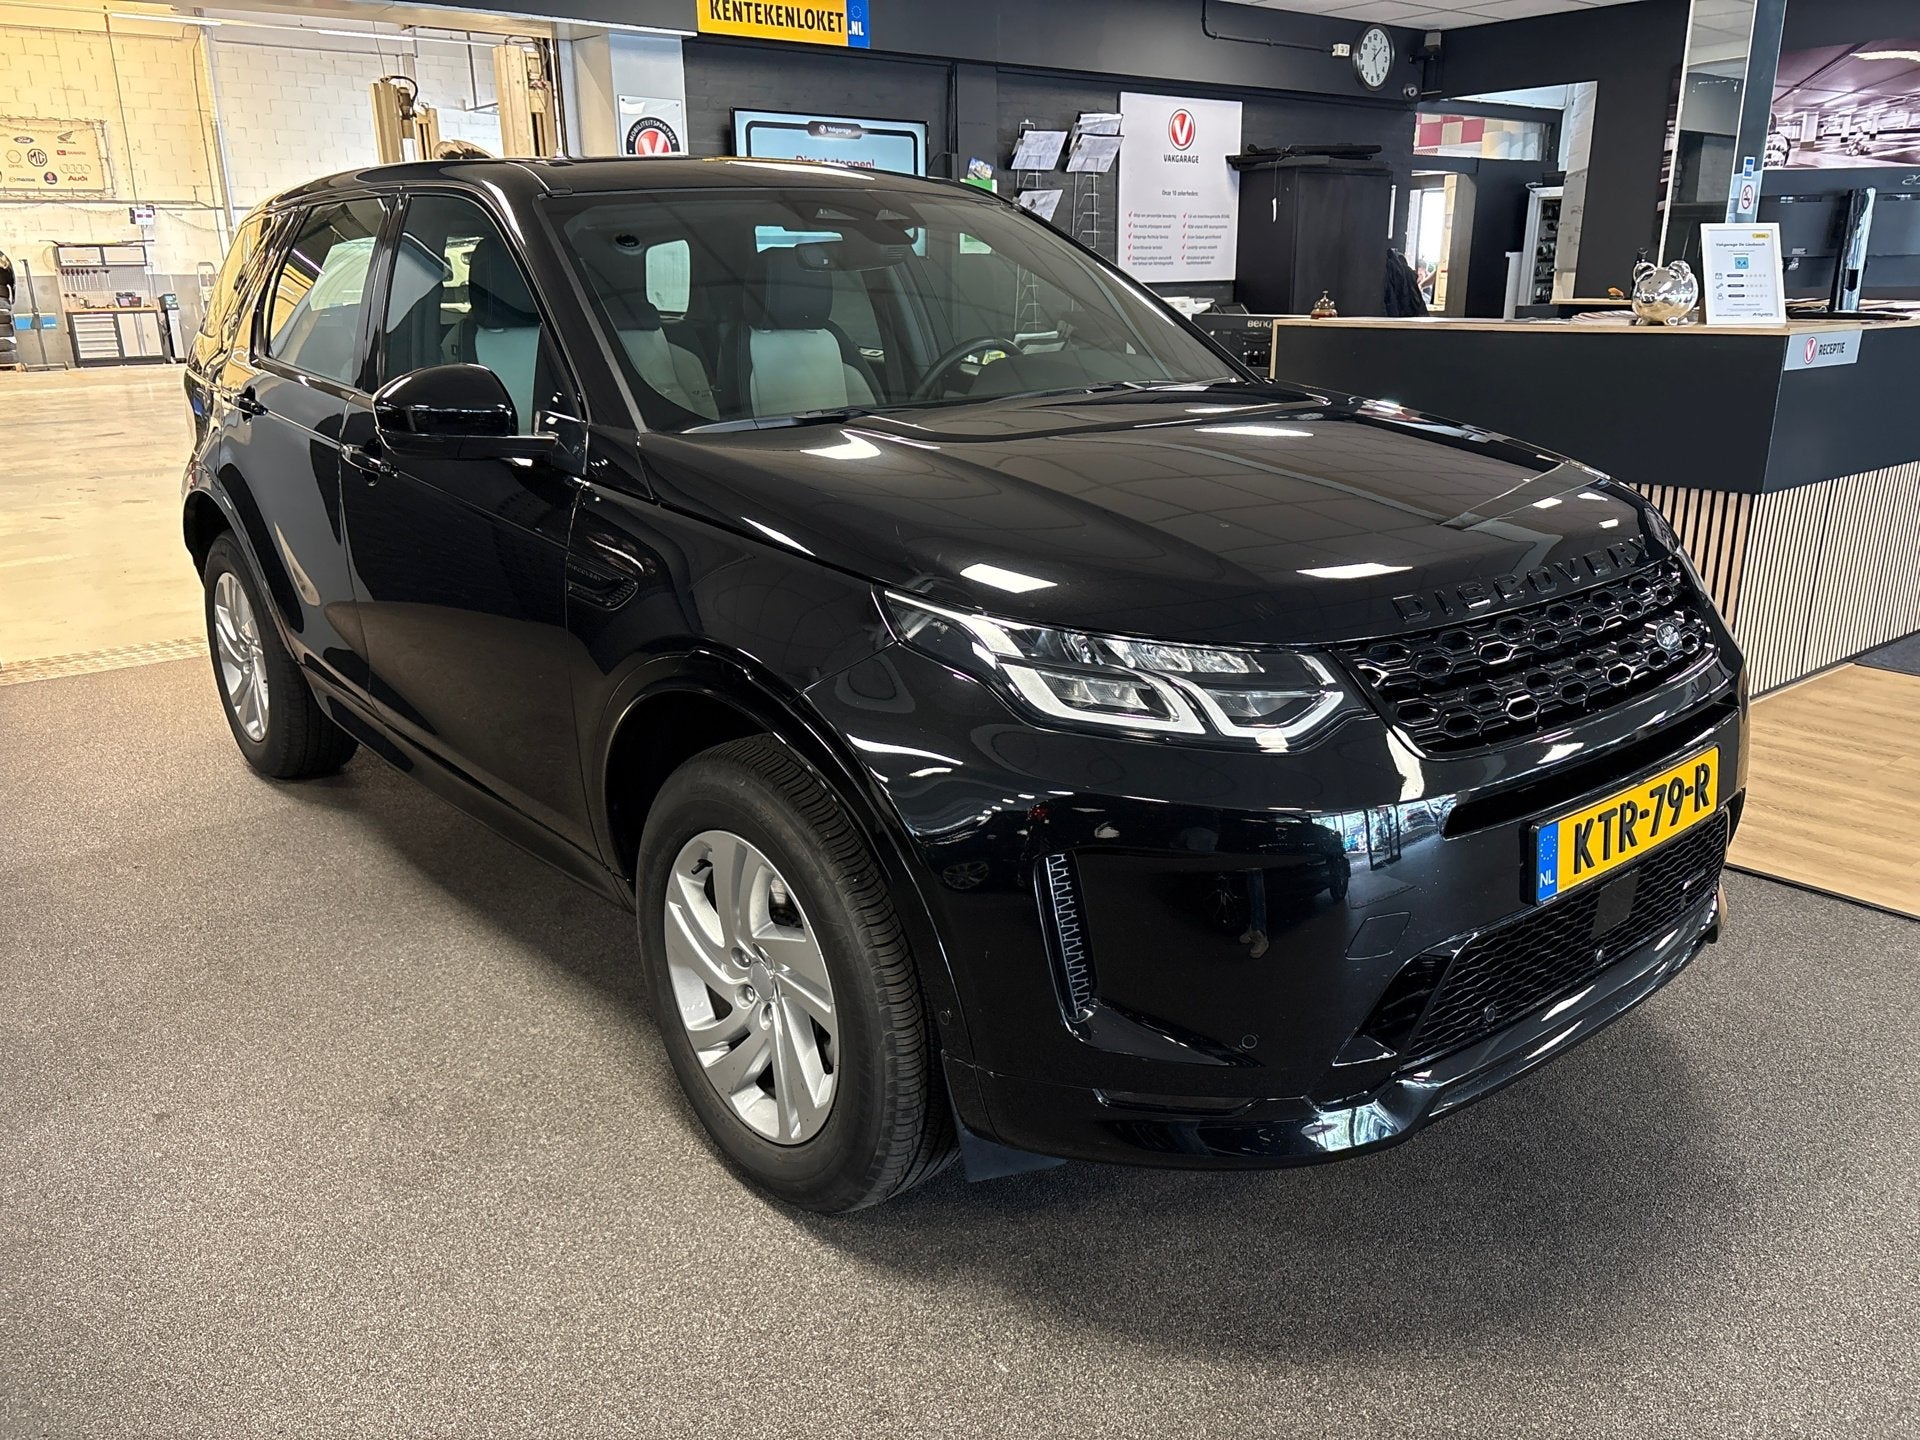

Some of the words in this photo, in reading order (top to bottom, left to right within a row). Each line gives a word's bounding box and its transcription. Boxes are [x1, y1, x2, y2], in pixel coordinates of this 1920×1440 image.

[710, 0, 844, 33] KENTEKENLOKET
[628, 120, 677, 145] MOBILITEITSPARTNER
[30, 151, 45, 164] MG
[1163, 154, 1199, 164] VAKGARAGE
[1247, 320, 1272, 329] BenQ
[1818, 342, 1846, 356] RECEPTIE
[1392, 534, 1649, 624] DISCOVERY
[1573, 762, 1711, 875] KTR-79-R
[1539, 869, 1555, 888] NL
